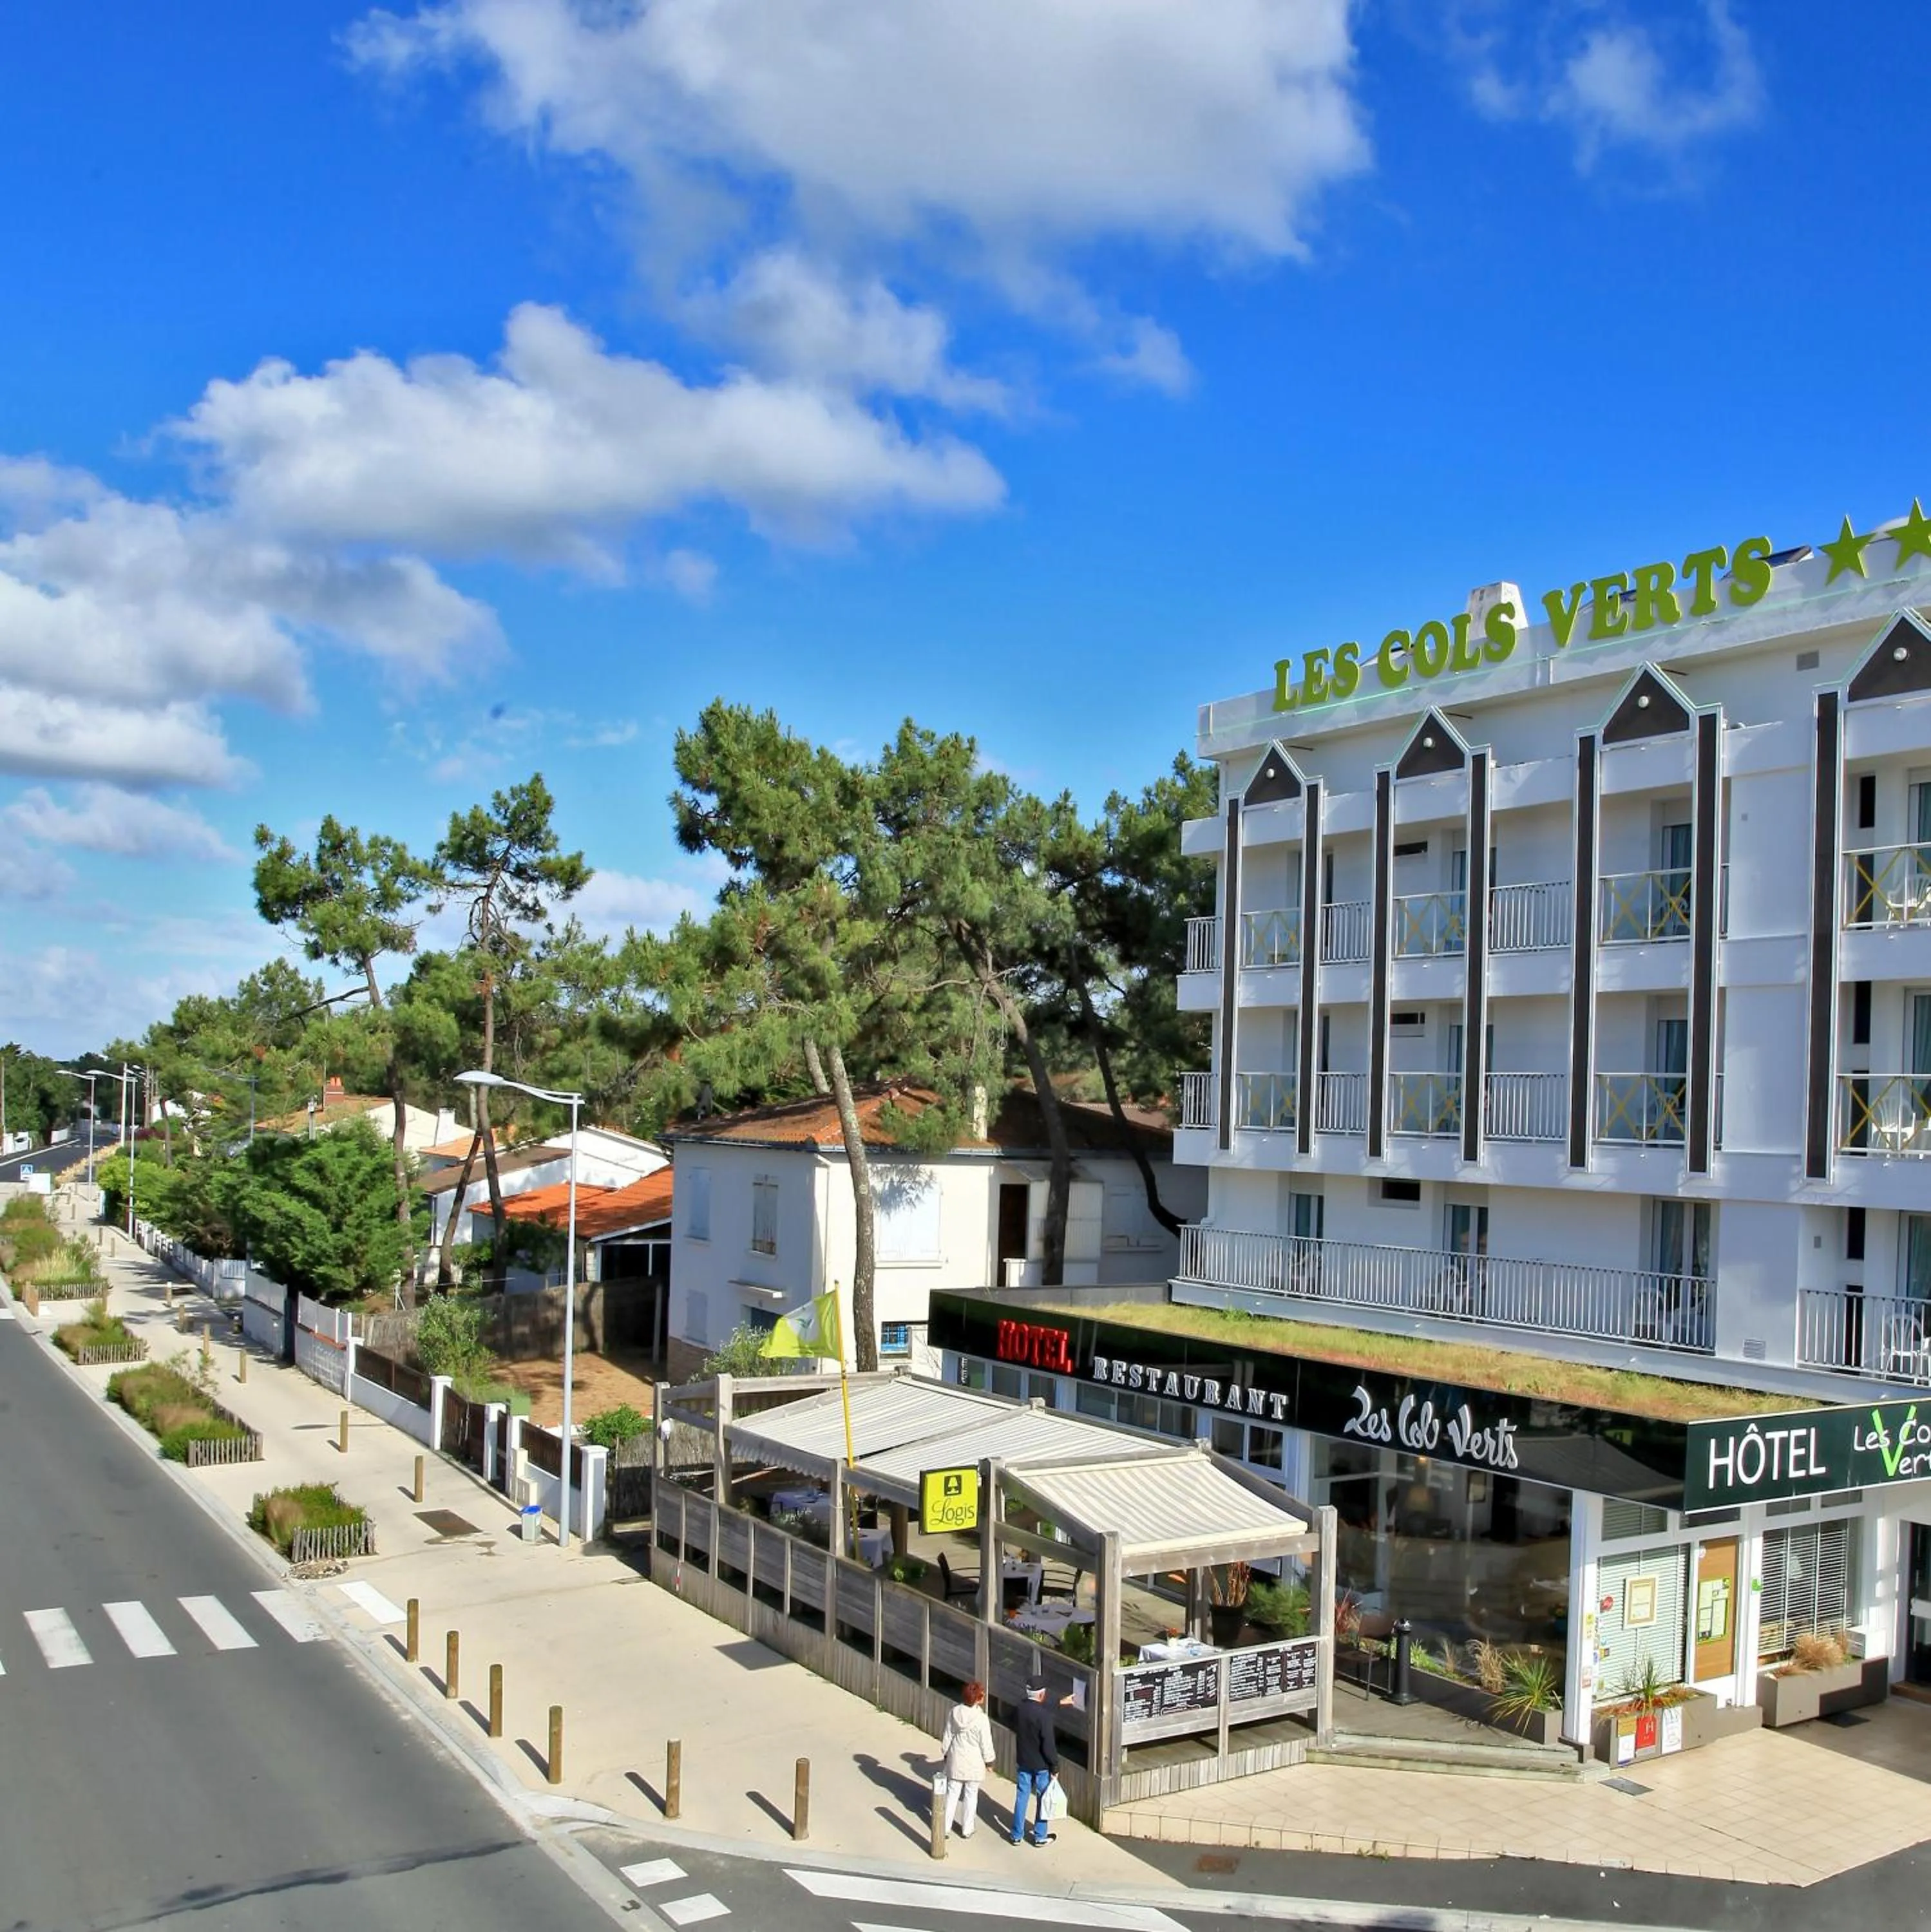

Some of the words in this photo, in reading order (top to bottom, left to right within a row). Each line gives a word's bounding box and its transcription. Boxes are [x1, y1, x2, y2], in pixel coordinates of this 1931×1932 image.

[1273, 641, 1361, 712] LES
[1377, 601, 1517, 688] COLS
[1541, 535, 1773, 649] VERTS
[998, 1320, 1072, 1372] HOTEL
[1092, 1356, 1288, 1420] RESTAURANT
[1343, 1385, 1392, 1442] Les
[1447, 1403, 1518, 1469] Verts
[1707, 1423, 1827, 1490] HÔTEL
[1853, 1425, 1890, 1451] Les
[929, 1497, 975, 1526] Logis
